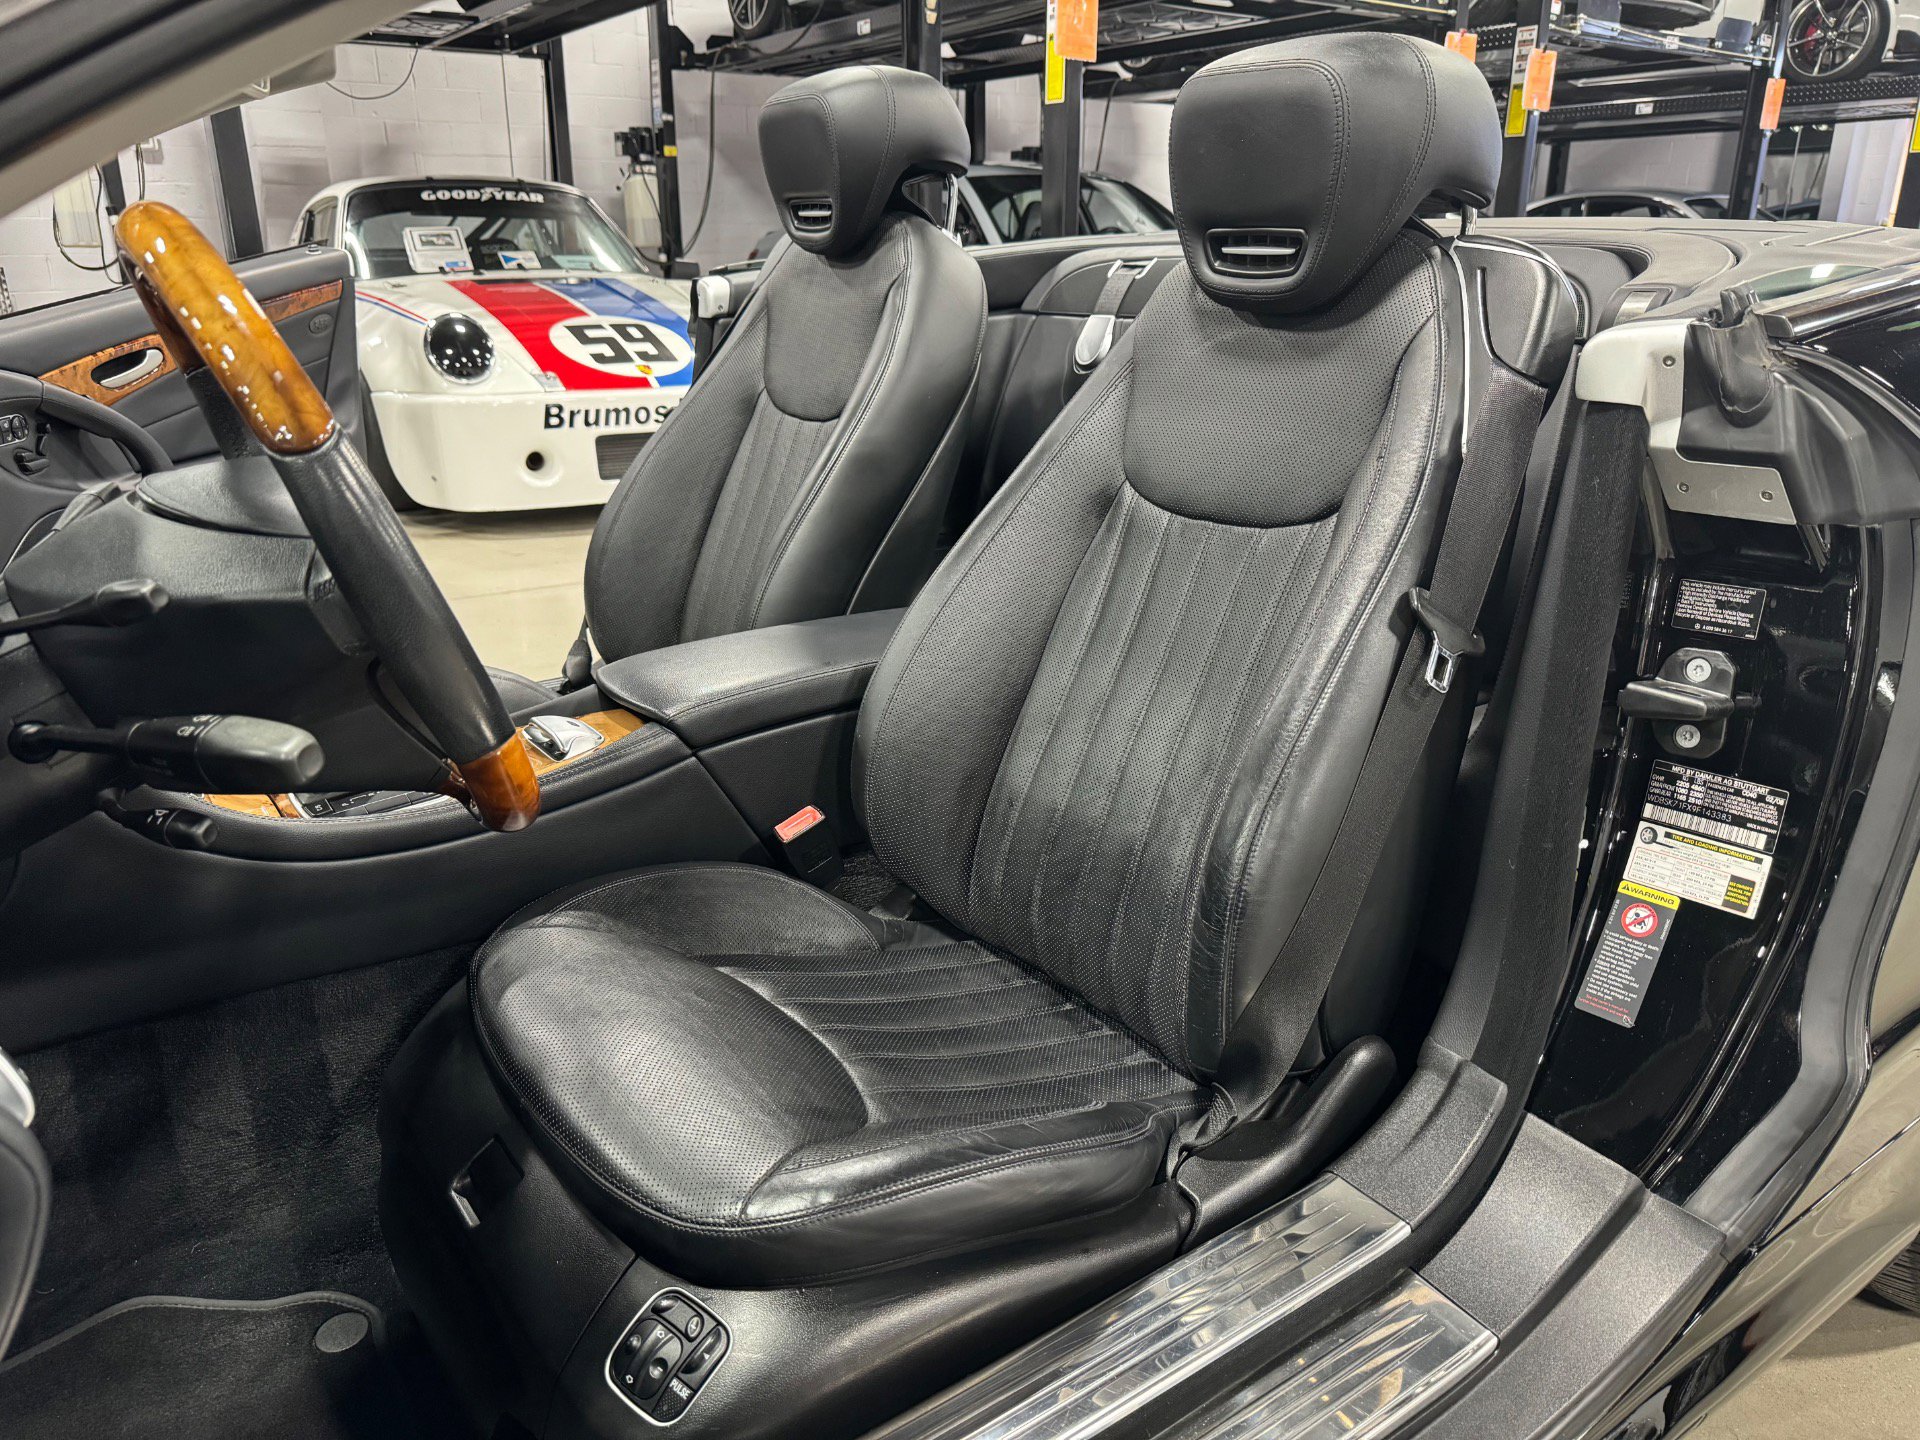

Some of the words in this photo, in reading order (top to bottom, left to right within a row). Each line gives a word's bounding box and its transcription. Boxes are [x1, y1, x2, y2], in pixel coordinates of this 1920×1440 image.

[420, 187, 544, 203] GOODYEAR
[564, 324, 678, 364] 59
[1672, 766, 1686, 774] MFD
[1695, 772, 1723, 783] DAIMLER
[1734, 781, 1770, 794] STUTTGART
[1676, 780, 1690, 789] 2205
[1695, 841, 1718, 851] LOADING
[1719, 848, 1755, 861] INFORMATION
[1630, 887, 1675, 905] WARNING
[669, 1378, 691, 1400] PULSE
